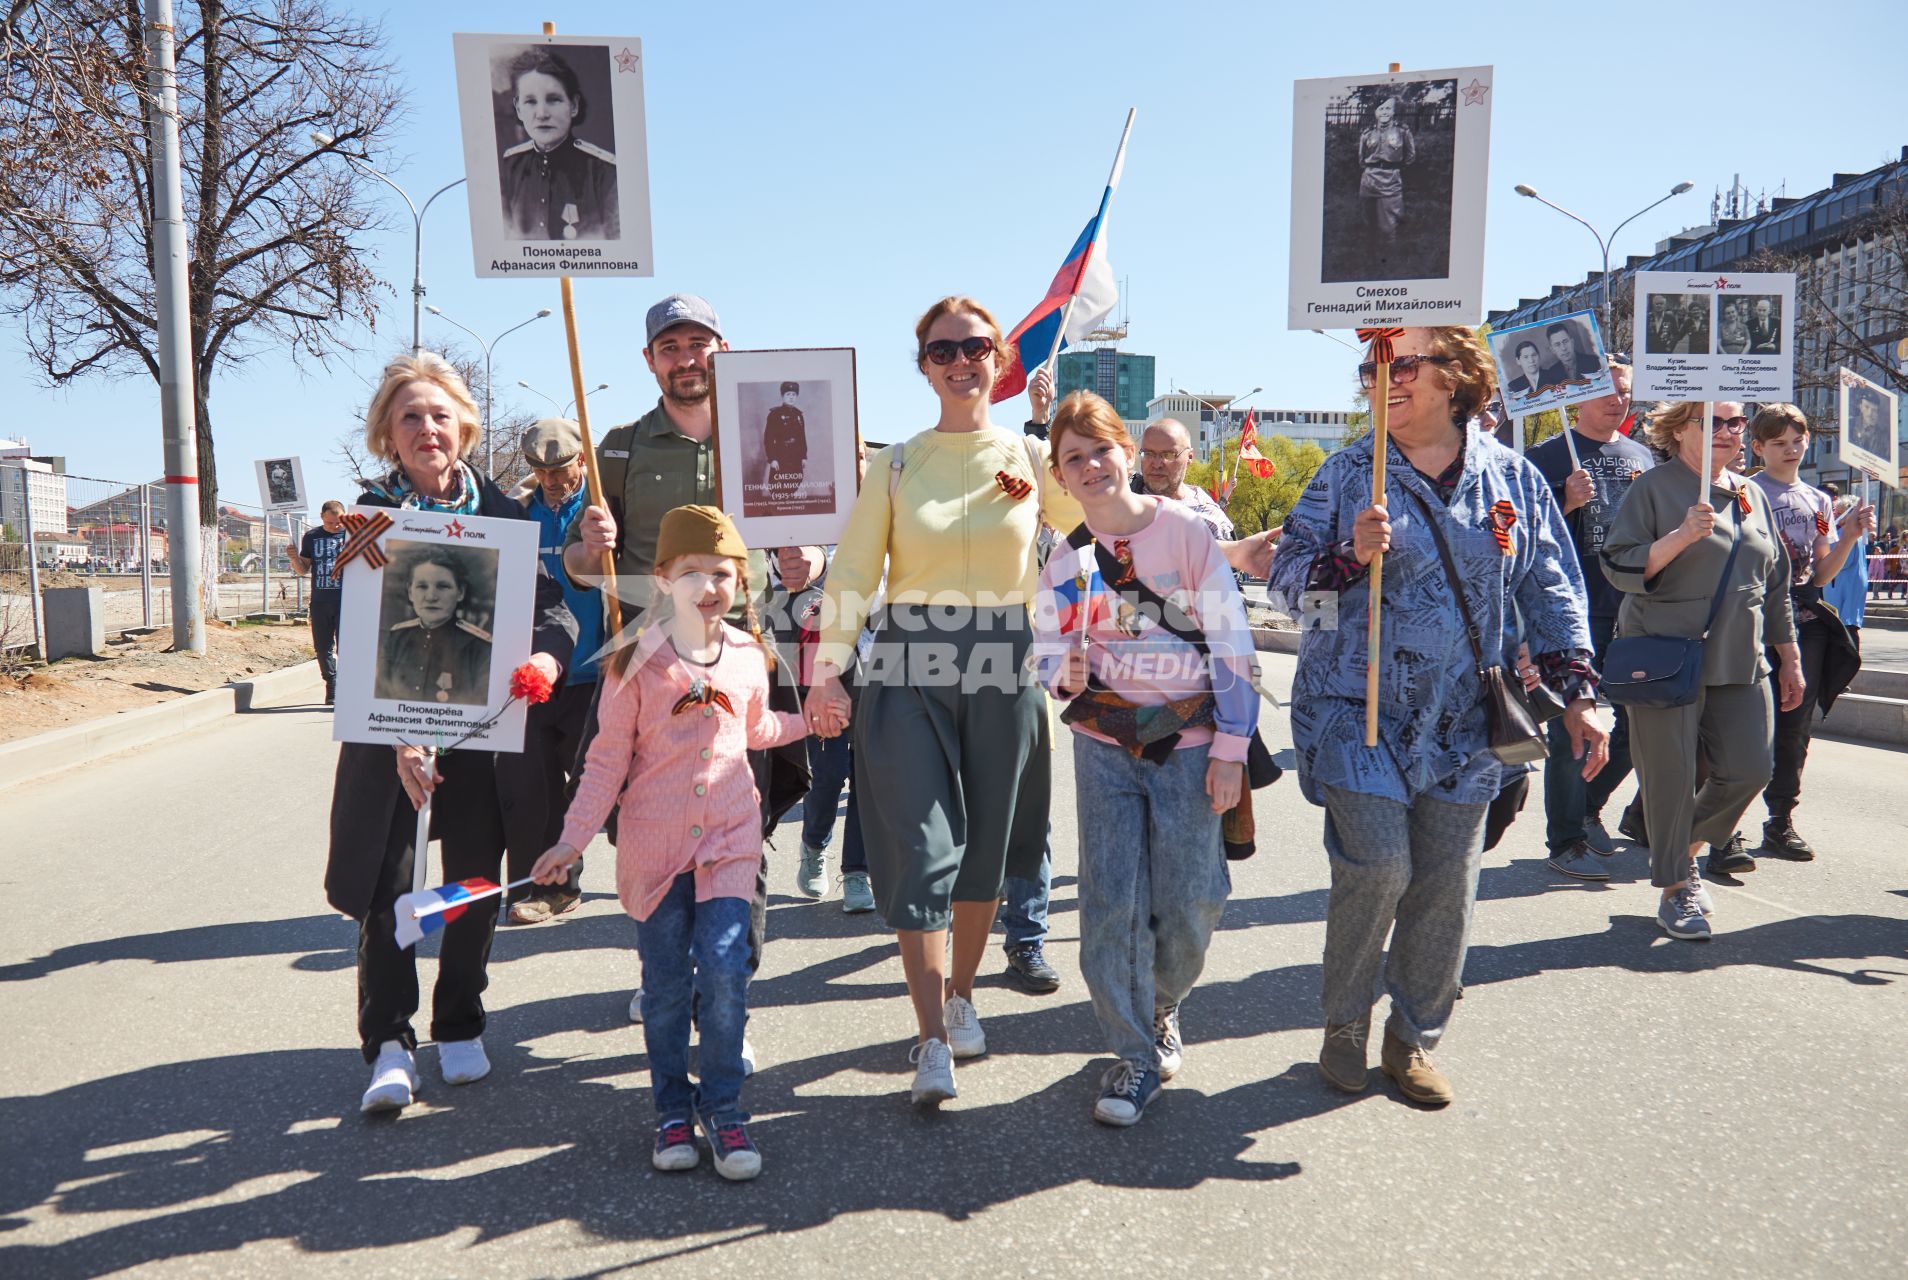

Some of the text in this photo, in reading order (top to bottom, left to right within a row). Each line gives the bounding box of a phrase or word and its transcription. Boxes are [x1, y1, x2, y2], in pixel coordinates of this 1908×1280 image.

[522, 246, 602, 258] Пономарева
[491, 259, 638, 272] Афанасия Филипповна
[1356, 286, 1408, 298] Смехов
[1307, 299, 1461, 314] Геннадий Михайлович
[1362, 316, 1403, 325] сержант
[773, 472, 804, 481] СМЕХОВ
[744, 482, 782, 491] ГЕННАДИЙ
[398, 703, 463, 717] Пономарёва
[368, 713, 490, 730] Афанасия Филипповна
[368, 725, 406, 734] лейтенант
[408, 729, 458, 738] медицинской
